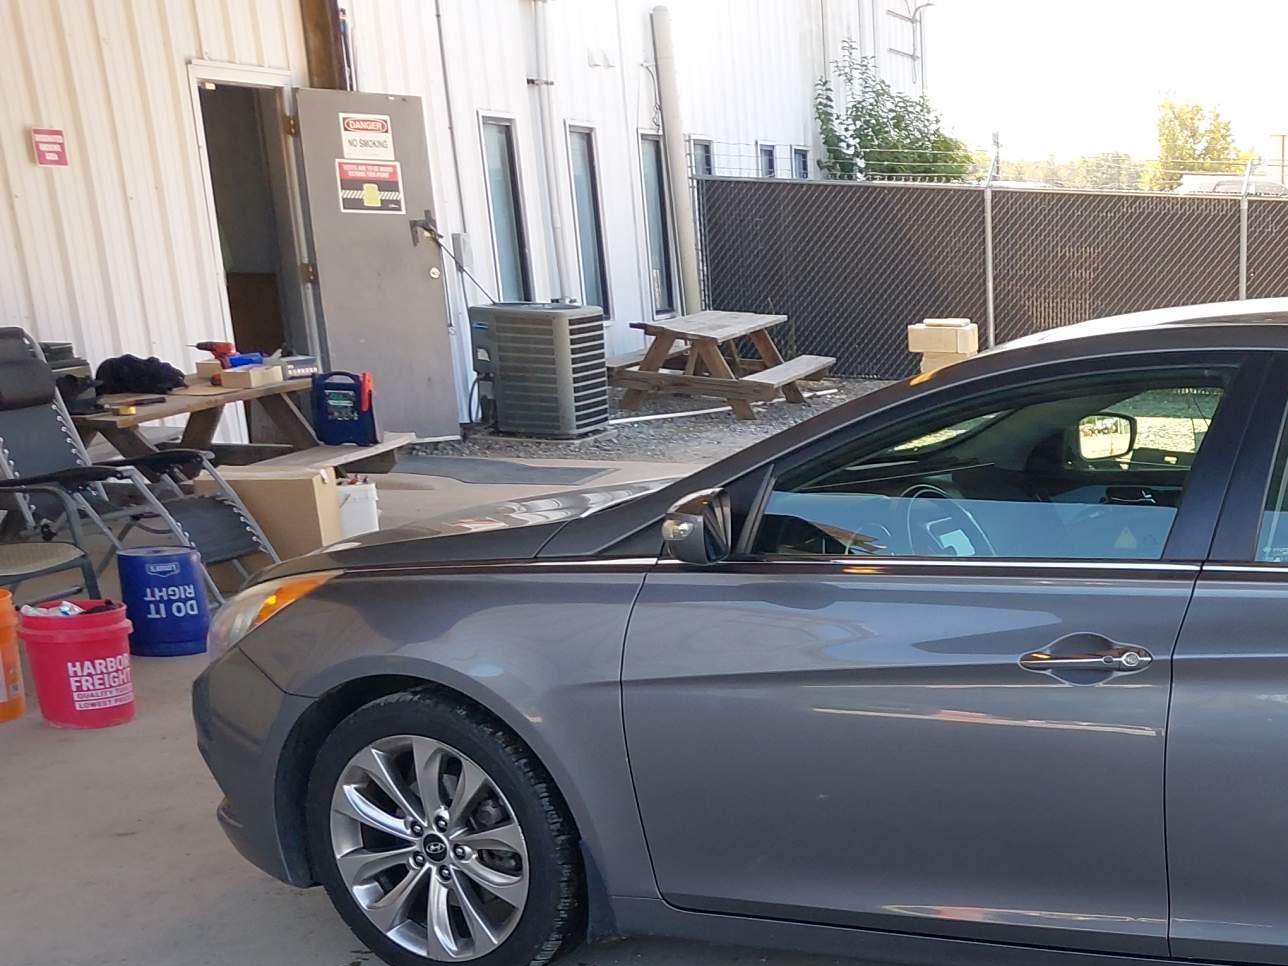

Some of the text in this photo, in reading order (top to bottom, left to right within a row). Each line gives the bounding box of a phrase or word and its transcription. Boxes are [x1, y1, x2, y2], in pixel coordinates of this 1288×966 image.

[349, 119, 383, 130] DANGER
[348, 138, 389, 149] NO SMOKING
[144, 584, 195, 601] RIGHT
[147, 600, 199, 618] DO IT
[69, 667, 132, 691] FREIGHT
